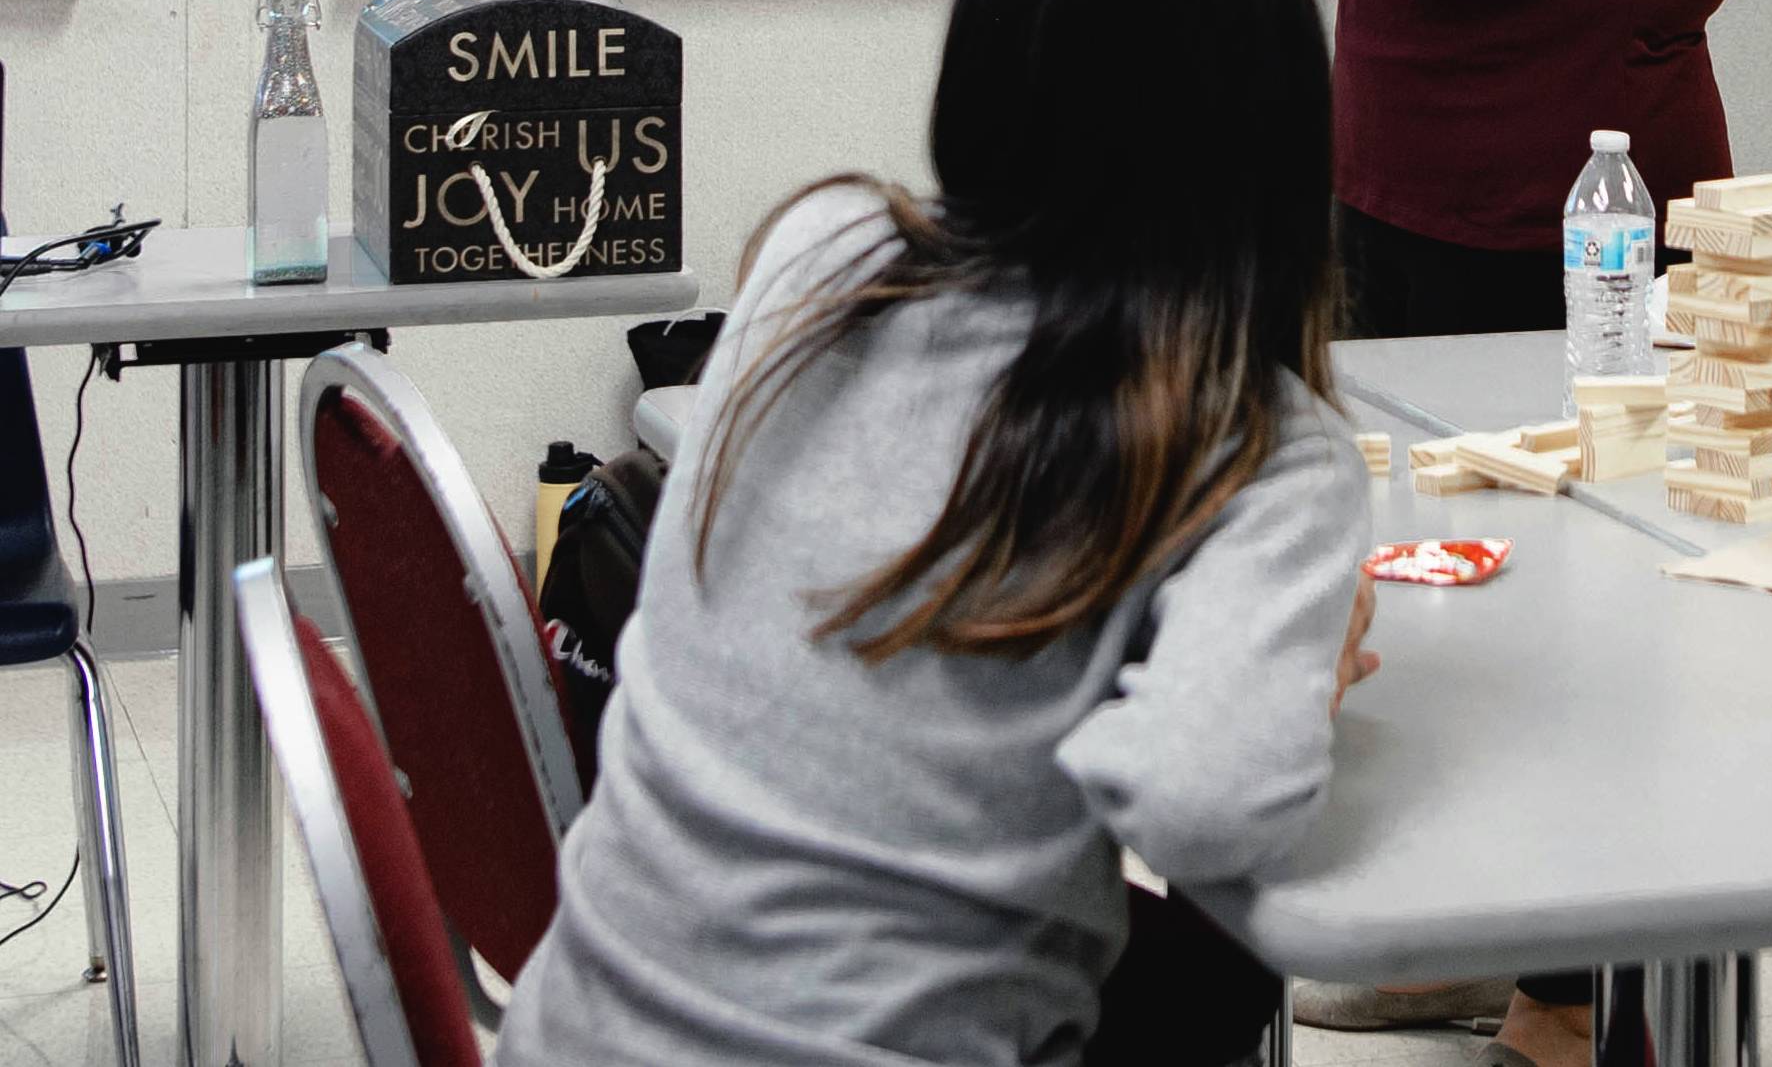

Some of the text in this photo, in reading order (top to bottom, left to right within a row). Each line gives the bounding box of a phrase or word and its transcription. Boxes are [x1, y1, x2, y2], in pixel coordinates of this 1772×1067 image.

[448, 28, 626, 82] SMILE
[578, 116, 669, 174] US
[403, 169, 540, 229] JOY
[553, 193, 665, 224] HOME
[414, 238, 665, 273] TOGEHENESS
